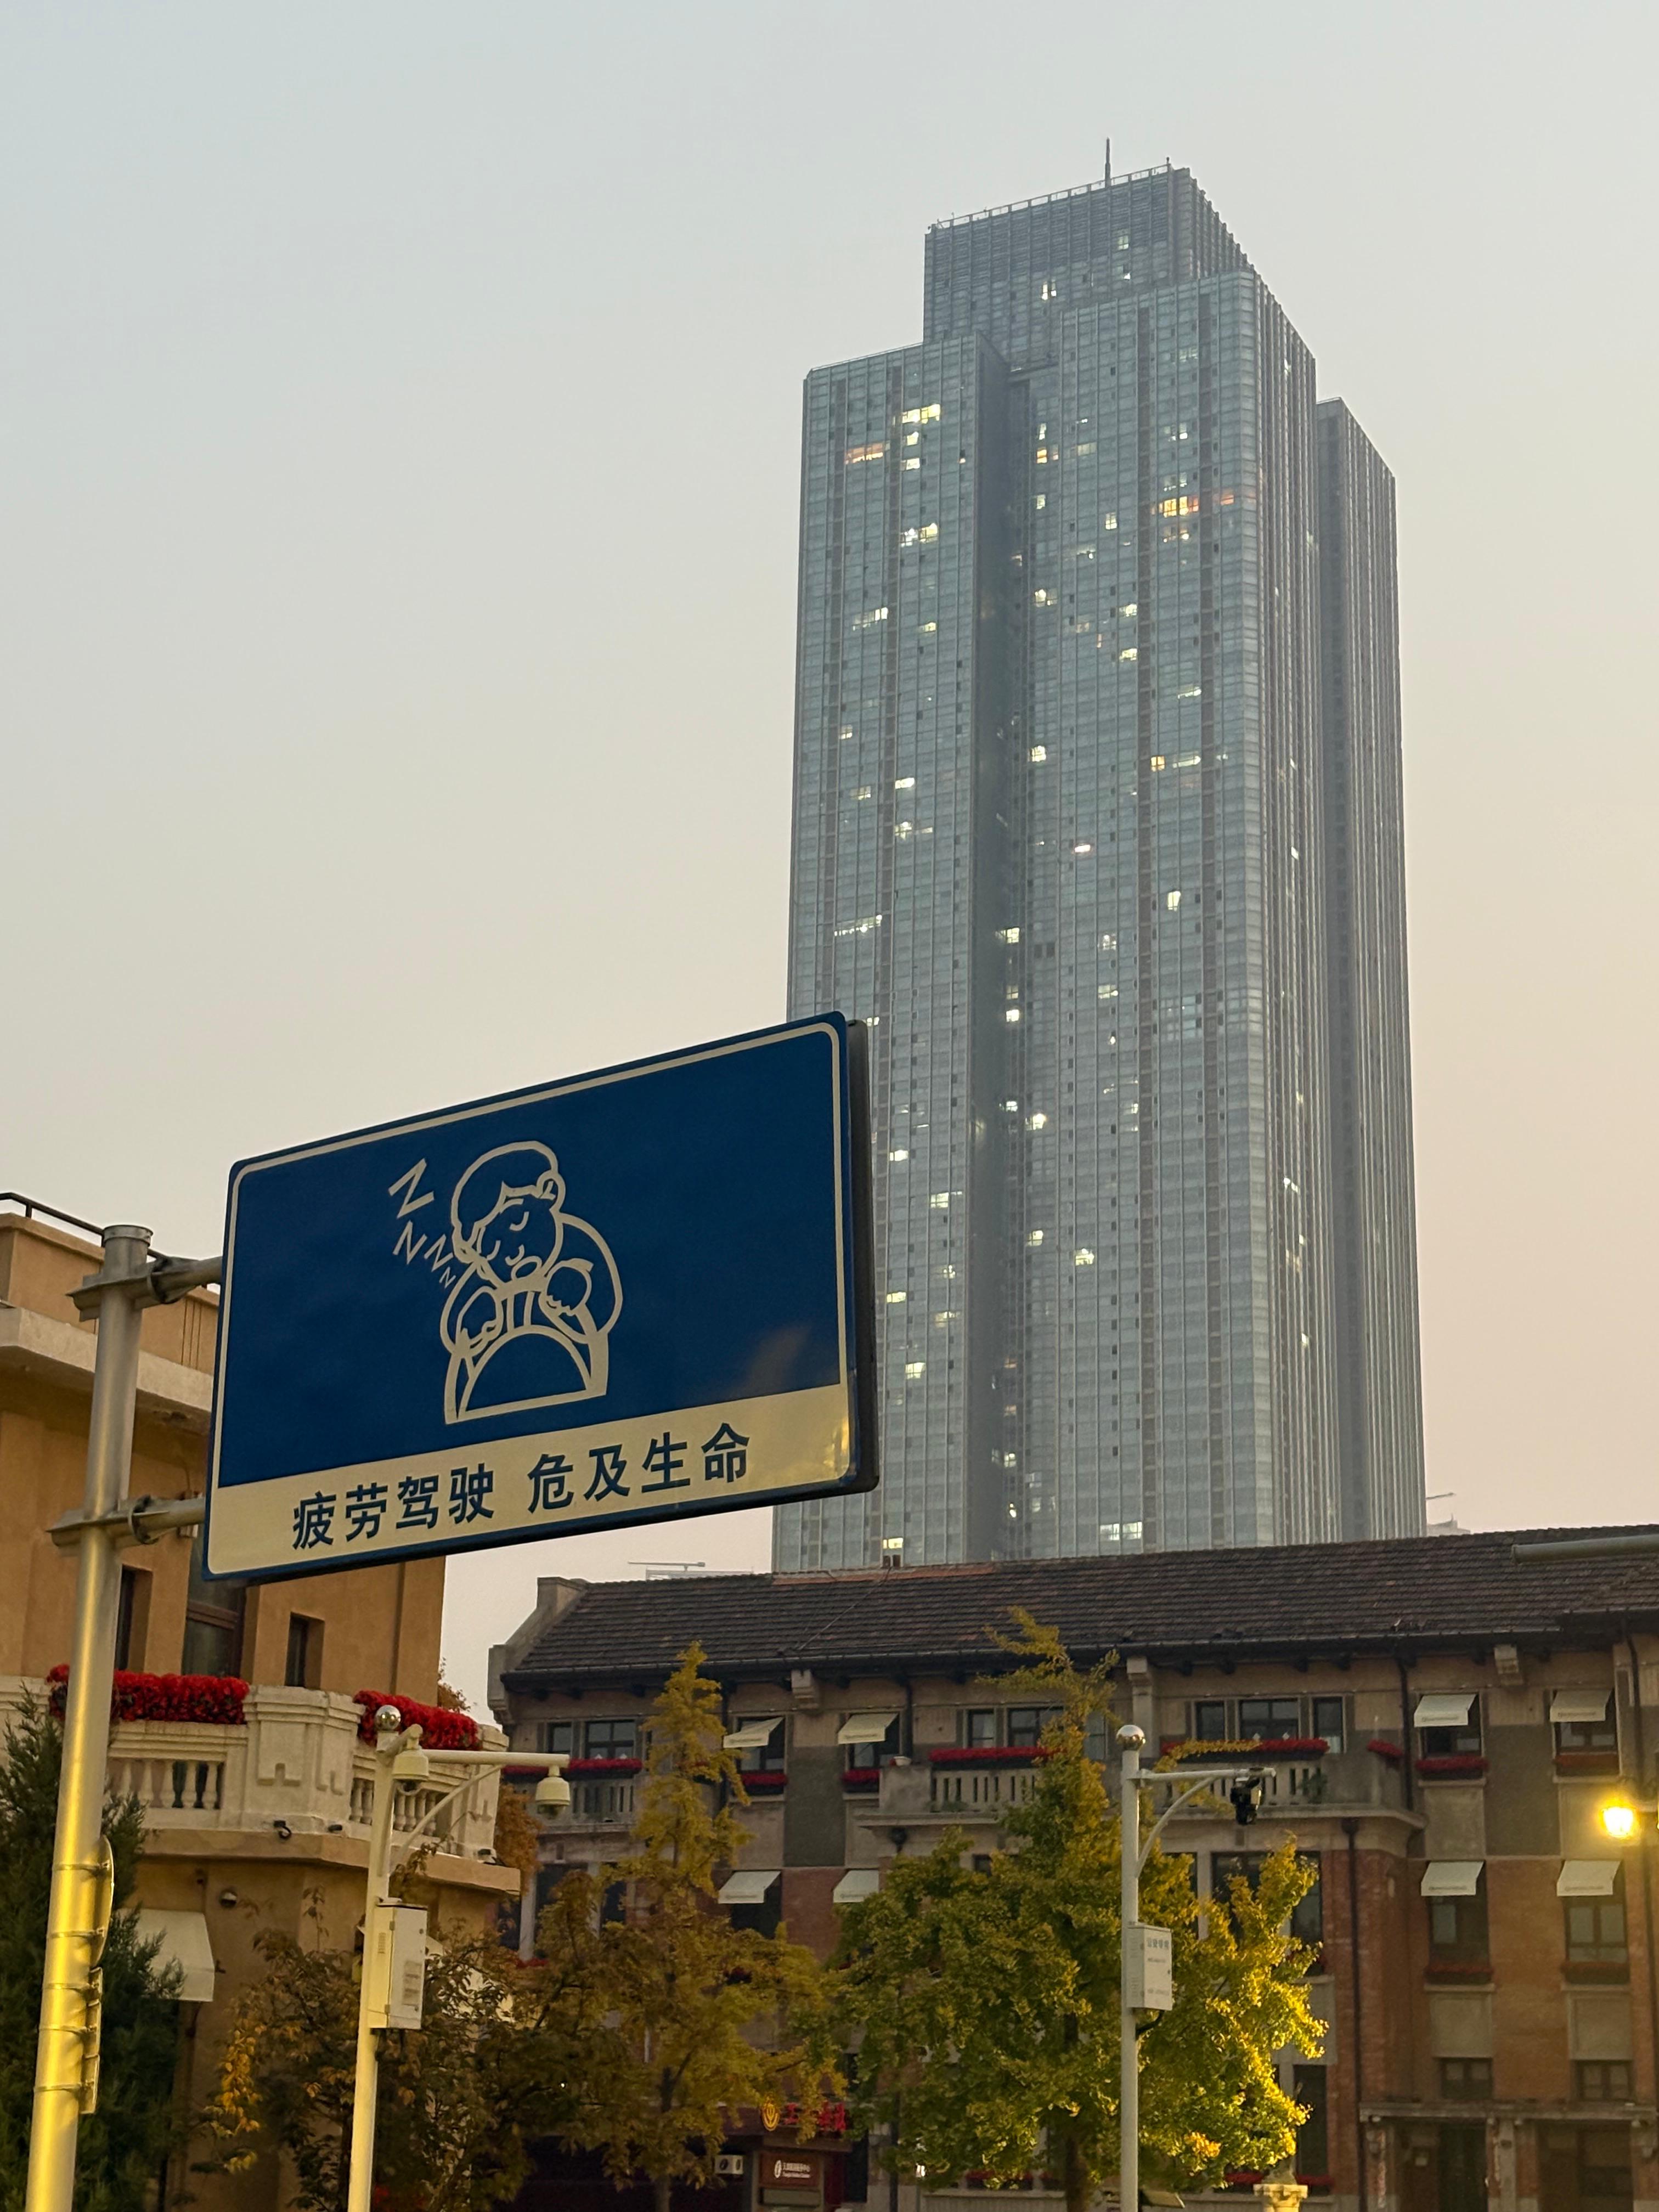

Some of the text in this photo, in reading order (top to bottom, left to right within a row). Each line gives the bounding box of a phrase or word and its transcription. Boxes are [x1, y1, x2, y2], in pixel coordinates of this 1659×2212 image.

[292, 1422, 750, 1550] 疲劳驾驶 危及生命
